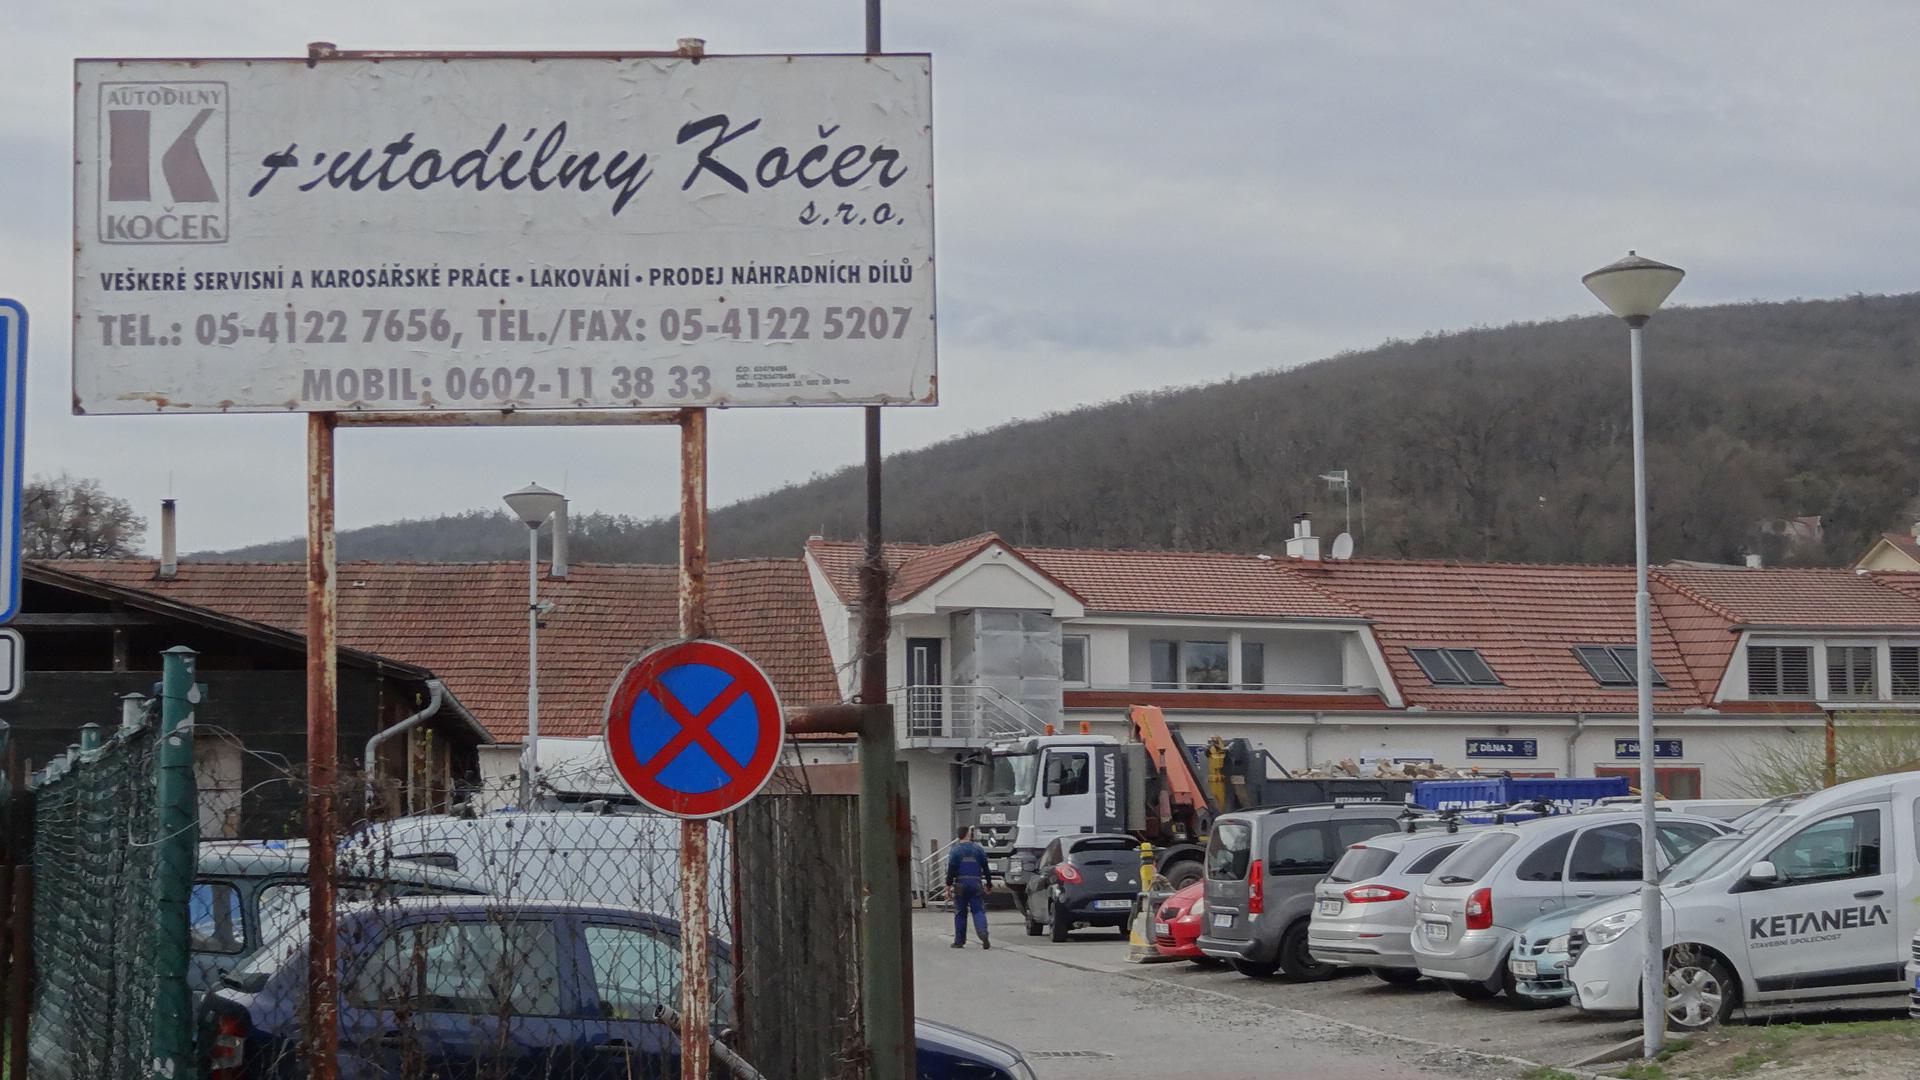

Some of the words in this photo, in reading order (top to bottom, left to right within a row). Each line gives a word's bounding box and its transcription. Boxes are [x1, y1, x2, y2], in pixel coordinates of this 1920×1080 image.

[675, 114, 908, 193] Kočer
[107, 206, 222, 240] KOČER
[798, 201, 905, 226] s.r.o.
[101, 267, 186, 291] VEŠKERÉ
[195, 265, 284, 290] SERVISNÍ
[291, 271, 303, 289] A
[311, 264, 440, 289] KAROSÁŘSKÉ
[448, 264, 510, 288] PRÁCE
[531, 264, 631, 288] LAKOVÁNÍ
[650, 265, 724, 287] PRODEJ
[732, 263, 861, 285] NÁHRADNÍCH
[869, 258, 912, 284] DÍLŮ
[98, 313, 181, 346] TEL.:
[196, 309, 347, 345] 05-4122
[362, 309, 463, 348] 7656,
[477, 308, 645, 345] TEL./FAX:
[660, 306, 809, 341] 05-4122
[823, 306, 912, 340] 5207
[302, 367, 432, 400] MOBIL:
[446, 366, 592, 400] 0602-11
[611, 366, 654, 399] 38
[668, 366, 711, 399] 33
[1480, 742, 1506, 752] DÍLNA
[1507, 744, 1514, 752] 2
[1104, 753, 1116, 818] KETANELA
[1750, 905, 1888, 939] KETANELA
